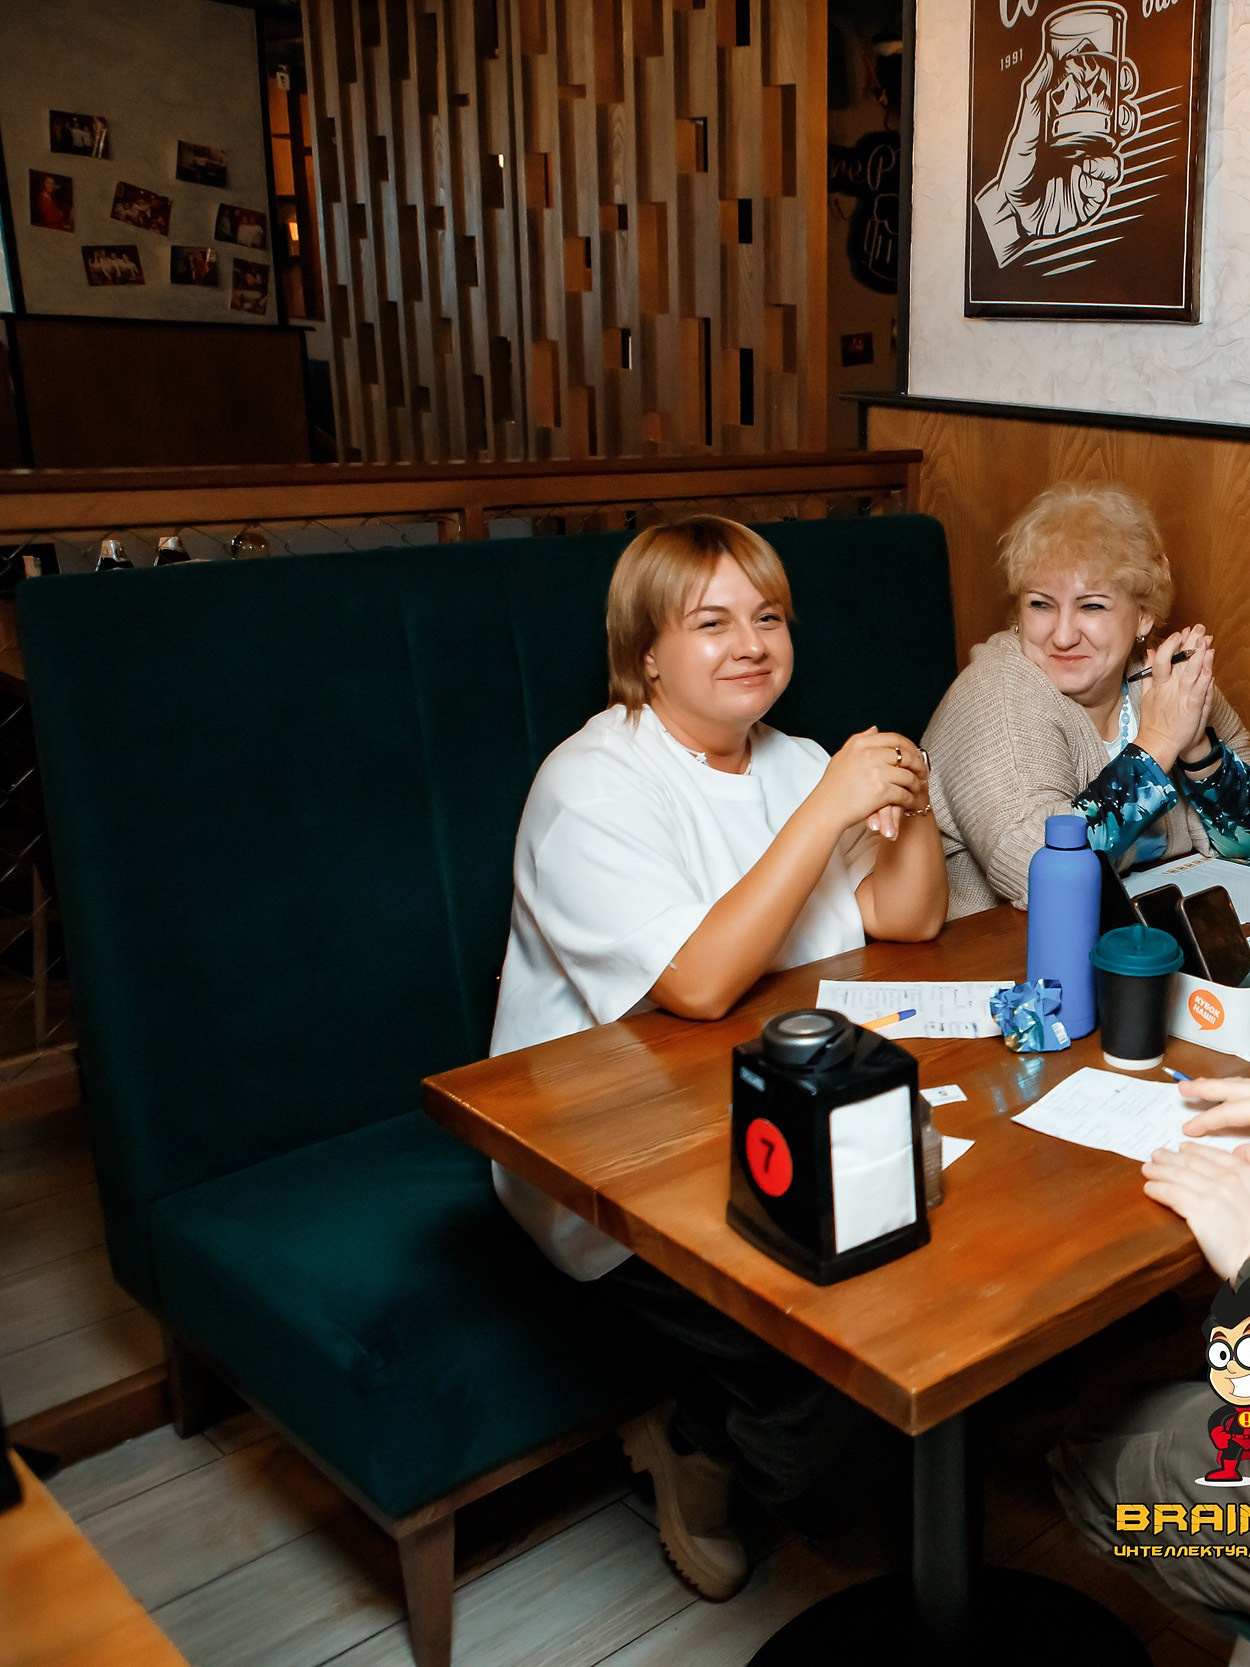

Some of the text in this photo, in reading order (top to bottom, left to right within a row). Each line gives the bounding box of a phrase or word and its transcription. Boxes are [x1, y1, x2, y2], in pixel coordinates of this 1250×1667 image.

[1000, 48, 1023, 71] 1991
[1194, 995, 1221, 1018] КУБОК
[760, 1138, 775, 1173] 7
